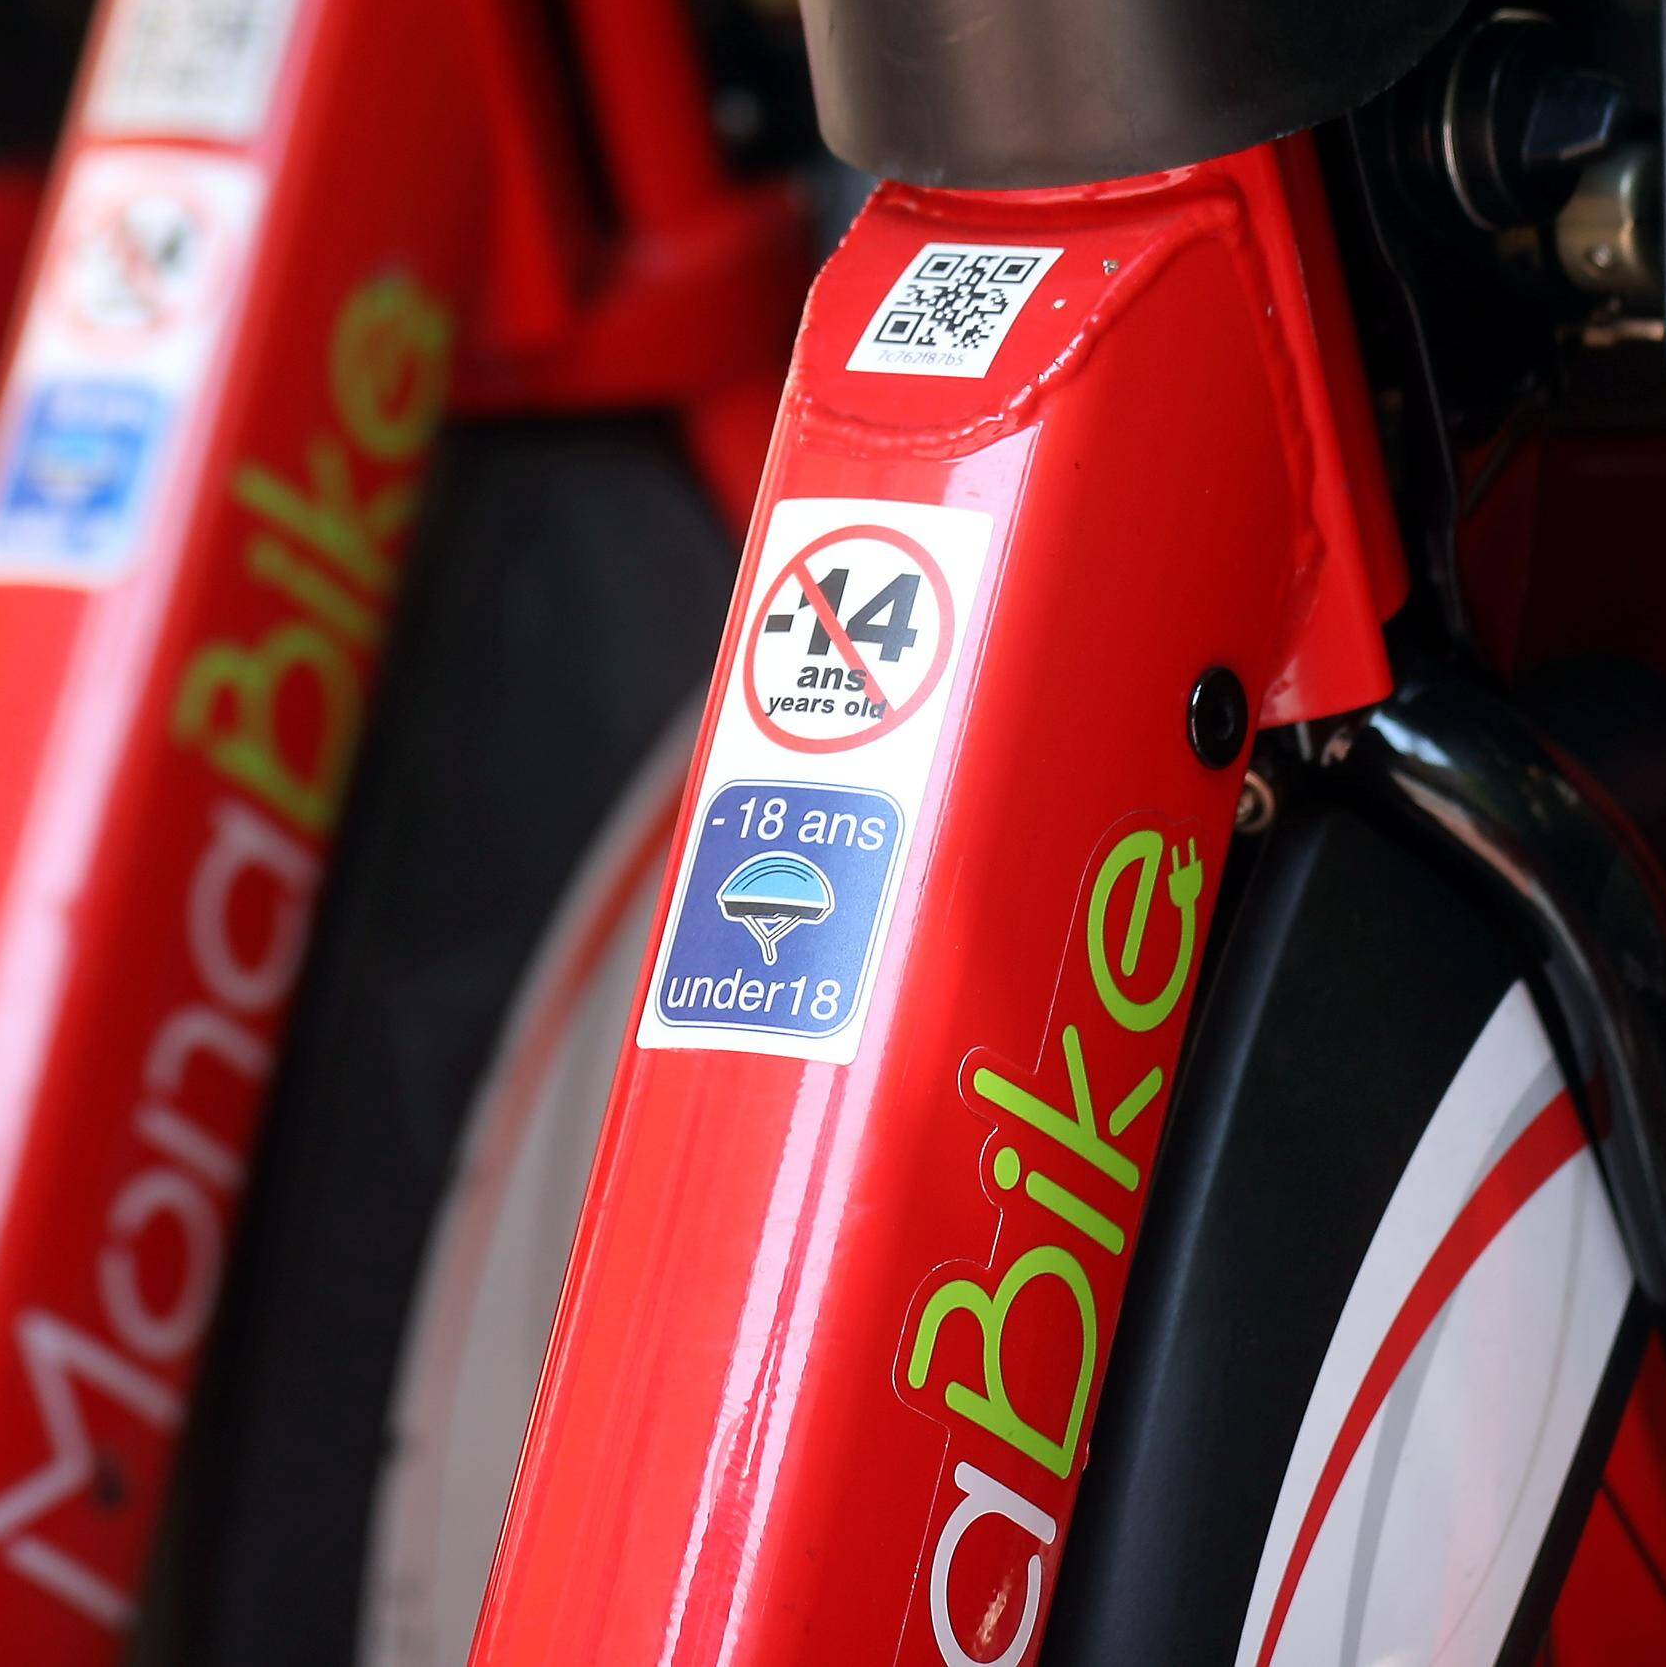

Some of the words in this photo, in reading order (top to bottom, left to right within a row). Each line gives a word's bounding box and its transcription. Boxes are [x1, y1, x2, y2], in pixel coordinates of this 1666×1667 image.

[764, 568, 921, 663] -14
[796, 665, 867, 692] ans
[765, 696, 834, 717] years
[844, 697, 889, 719] old
[798, 809, 886, 851] ans
